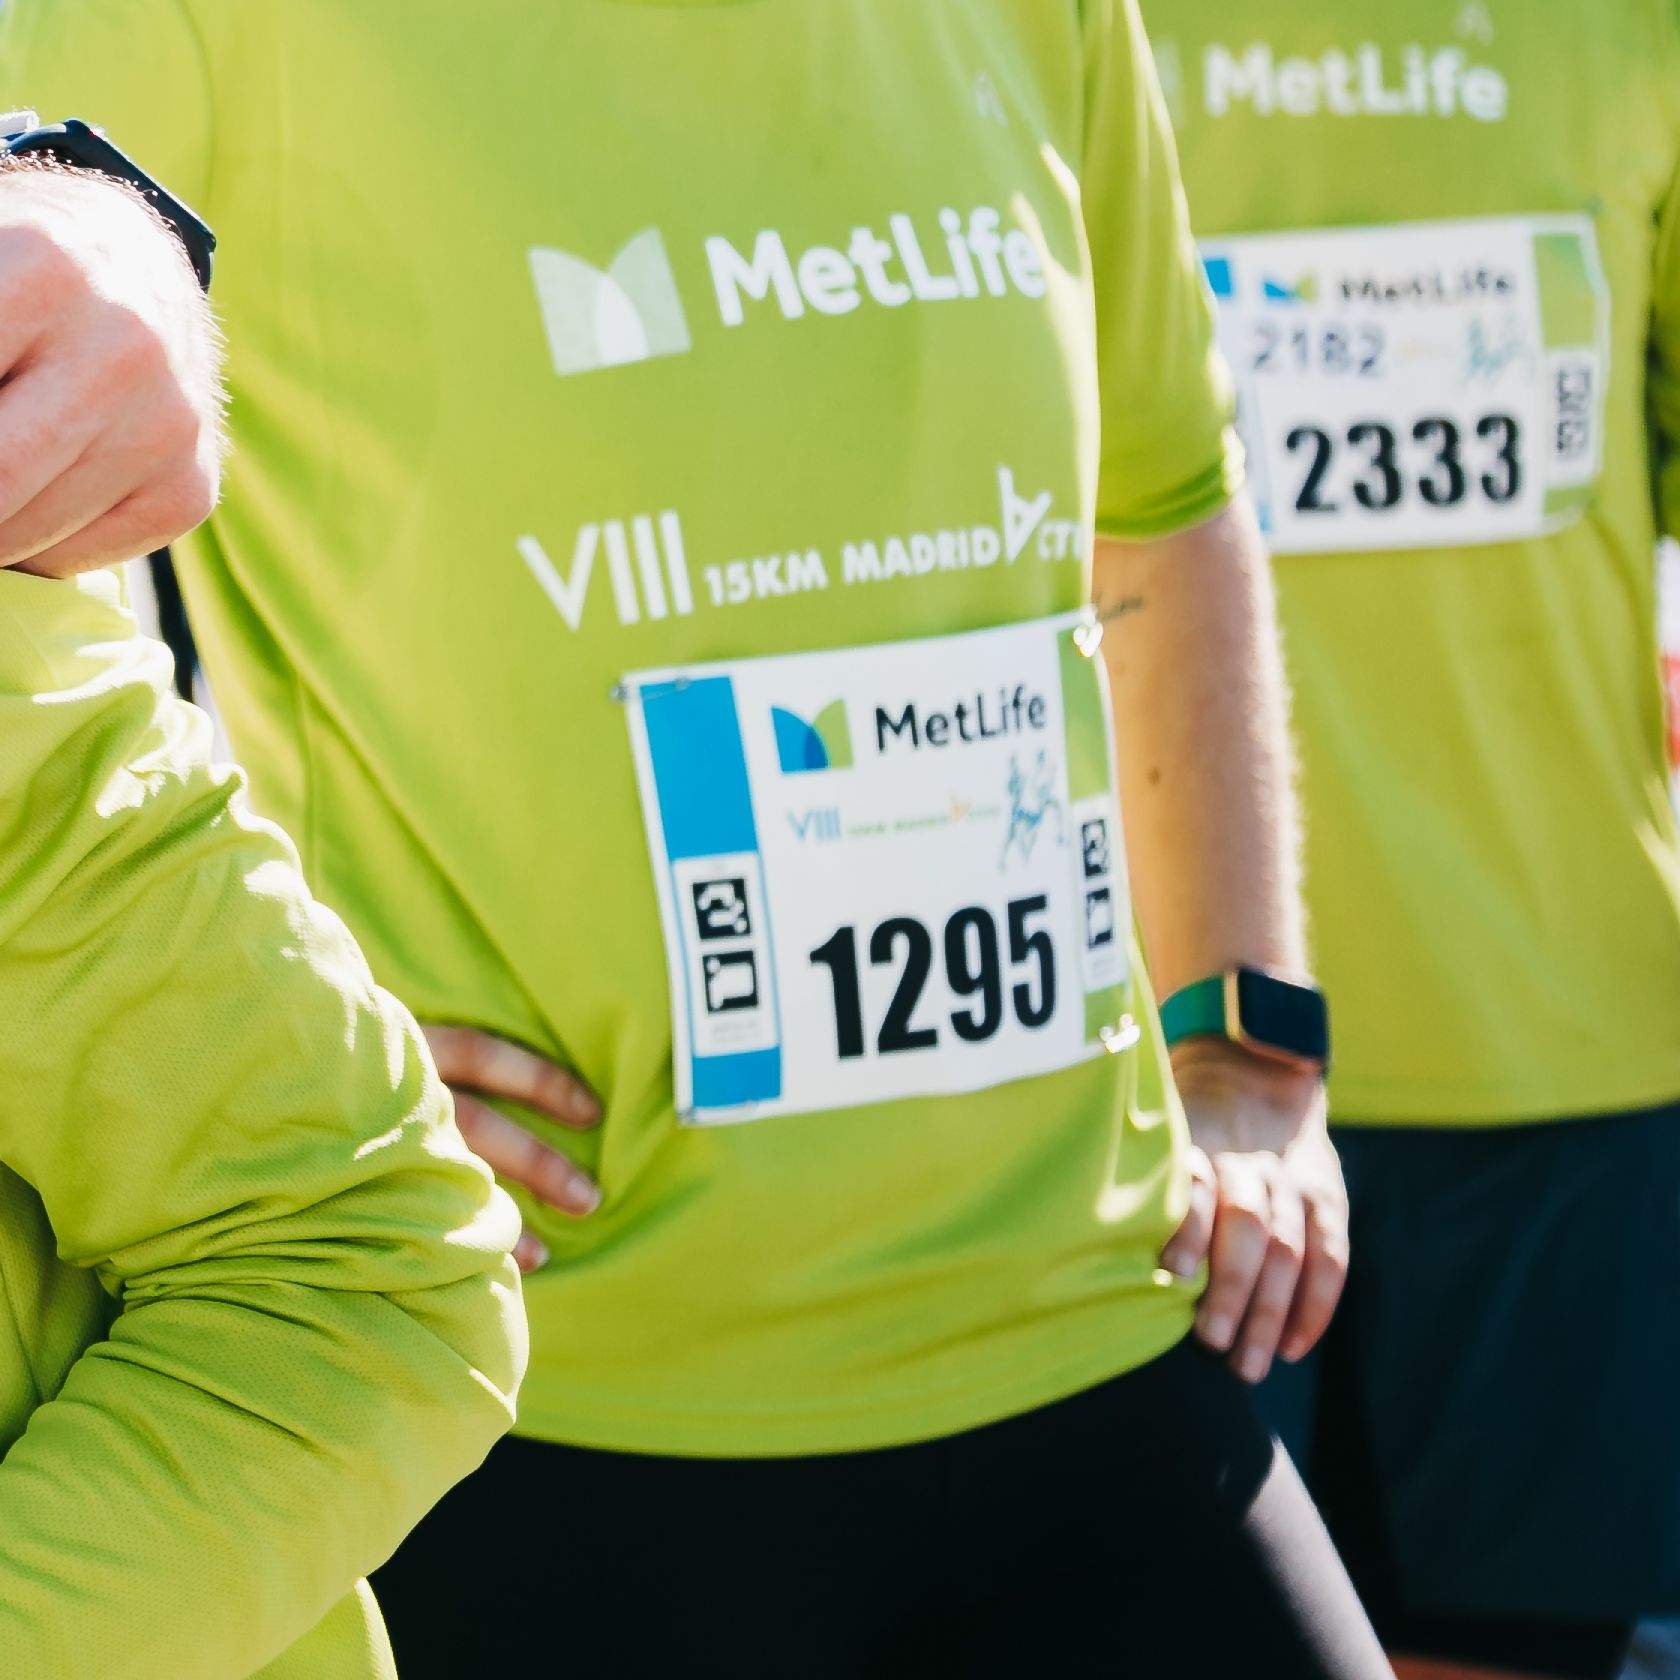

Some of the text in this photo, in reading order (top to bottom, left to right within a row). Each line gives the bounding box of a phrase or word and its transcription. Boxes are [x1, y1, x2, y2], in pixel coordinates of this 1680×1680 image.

[1204, 43, 1507, 121] MetLife
[704, 206, 1047, 327] MetLife
[1286, 414, 1522, 514] 2333
[516, 508, 693, 632] VIII
[703, 551, 829, 608] 15KM
[874, 682, 1047, 754] MetLife
[810, 893, 1058, 1060] 1295
